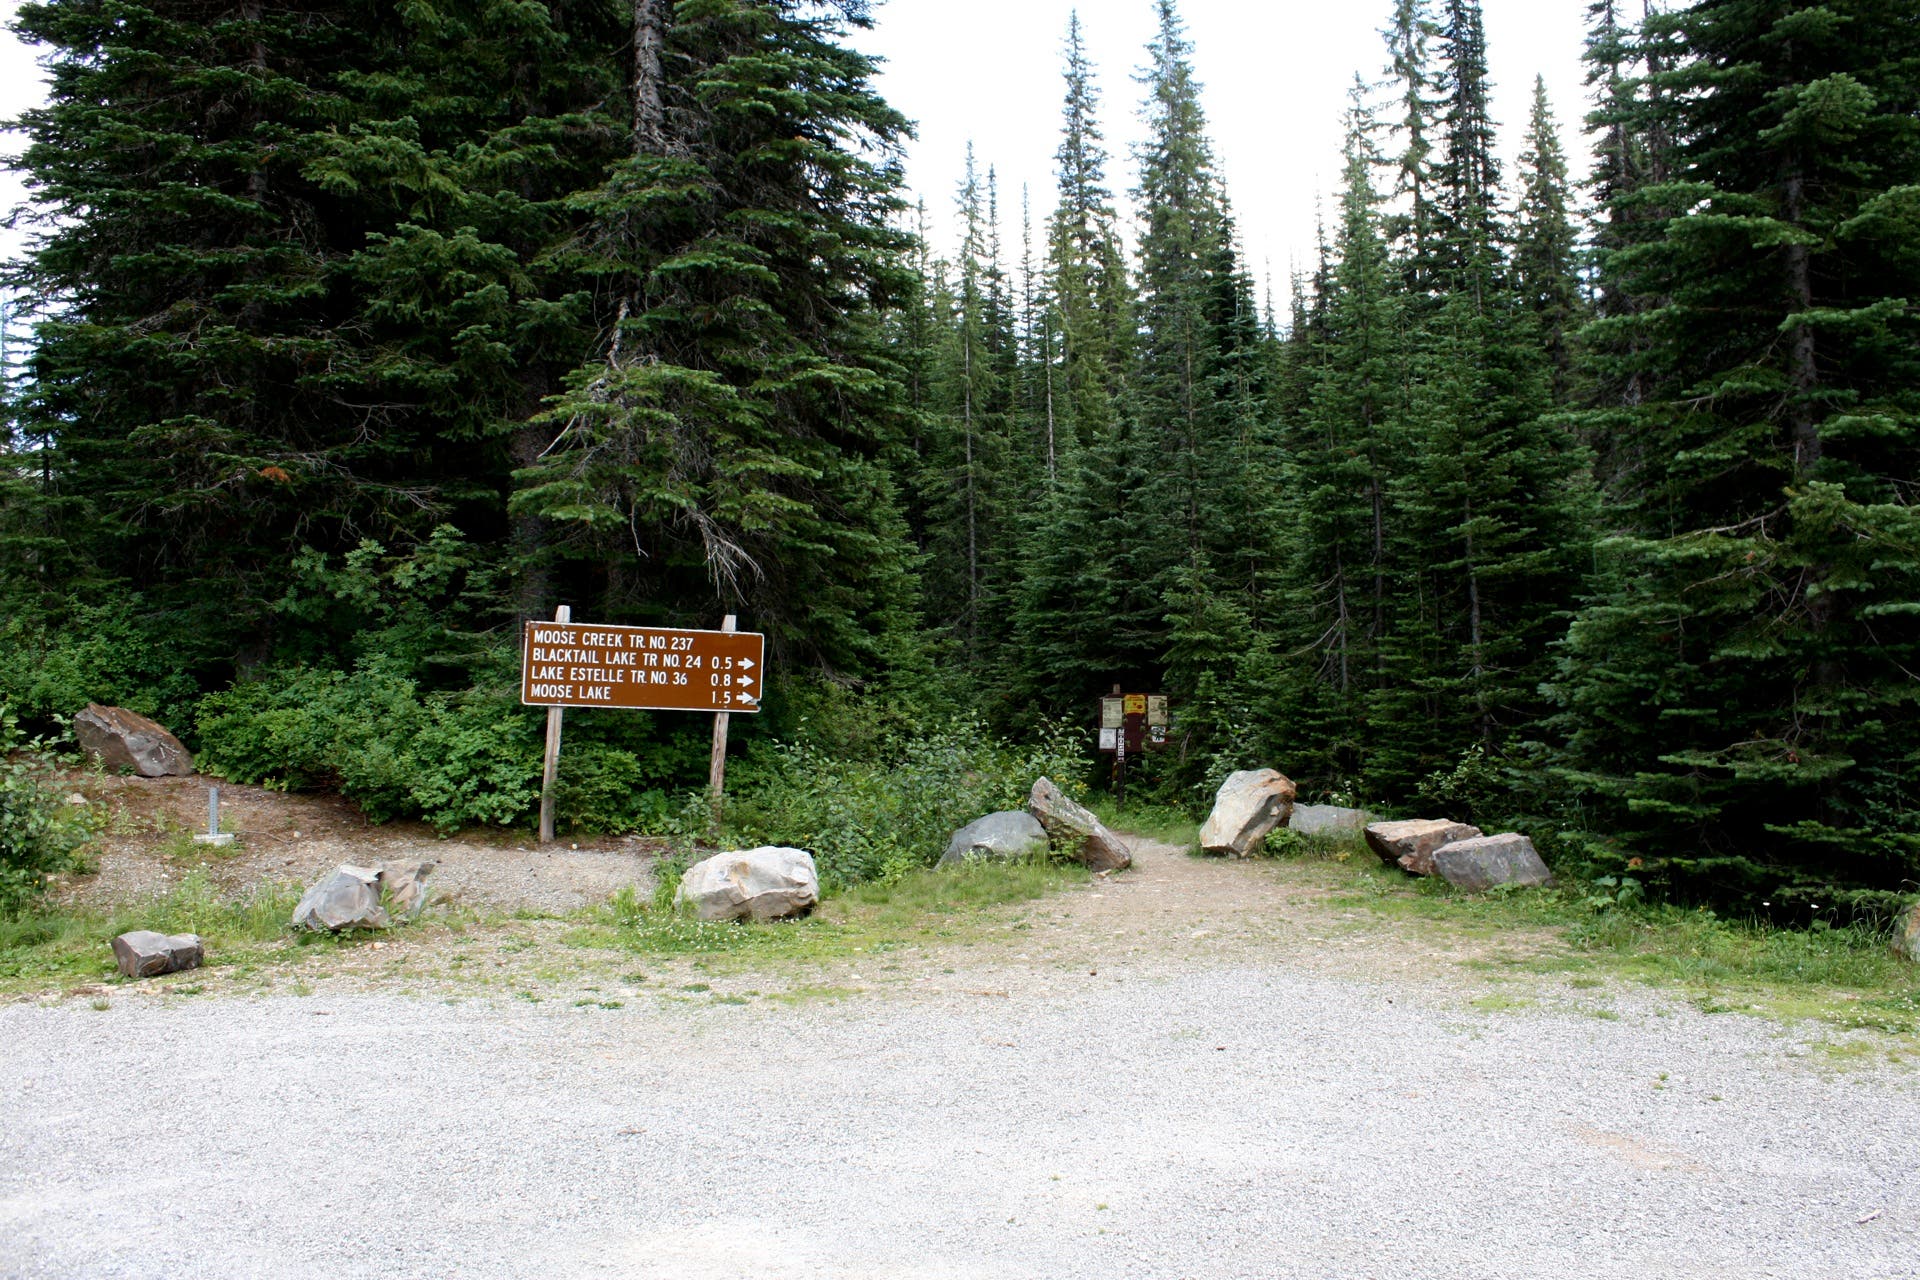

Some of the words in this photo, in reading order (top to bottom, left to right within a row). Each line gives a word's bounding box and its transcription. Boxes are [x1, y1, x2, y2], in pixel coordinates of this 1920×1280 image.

[534, 630, 576, 644] MOOSE
[582, 633, 622, 647] CREEK
[671, 637, 694, 650] 237
[533, 648, 599, 664] BLACKTAIL
[605, 651, 636, 665] LAKE
[685, 656, 701, 668] 24
[712, 656, 732, 669] 0.5
[532, 666, 564, 680] LAKE
[570, 668, 623, 682] ESTELLE
[672, 672, 688, 685] 36
[711, 674, 730, 687] 0.8
[531, 684, 572, 698] MOOSE
[579, 686, 611, 699] LAKE
[711, 691, 730, 704] 1.5
